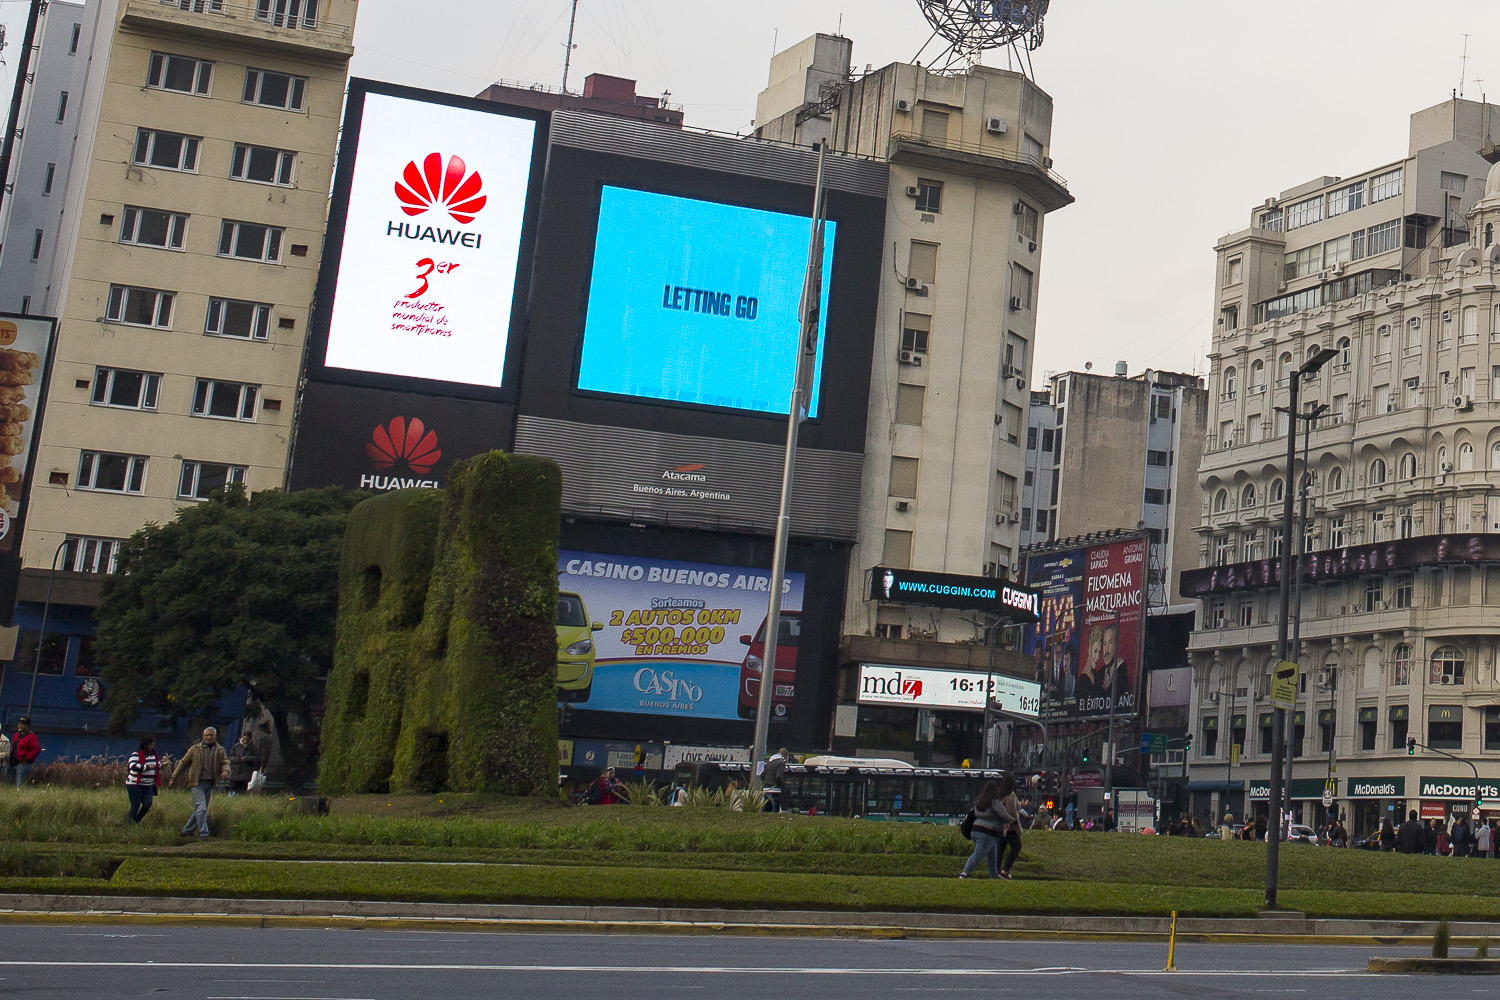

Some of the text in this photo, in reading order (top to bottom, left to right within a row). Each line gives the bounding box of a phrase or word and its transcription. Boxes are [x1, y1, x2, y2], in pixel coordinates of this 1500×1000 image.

[387, 220, 481, 249] HUAWEI
[393, 300, 445, 312] productor
[663, 284, 758, 321] LETTING GO
[393, 312, 448, 325] mundial de
[391, 323, 452, 337] smartphones
[360, 474, 438, 490] HUAWEI
[662, 471, 706, 481] Atacama
[633, 484, 730, 500] Buenos Aires, Argentina
[566, 559, 792, 594] CASINO BUENOS AIRS
[1087, 571, 1132, 592] FILOMENA
[899, 581, 996, 599] WWW.CUGGINI.COM
[651, 598, 704, 609] Sorteamos
[609, 610, 623, 626] 2
[625, 610, 694, 626] AUTOS
[621, 626, 725, 645] $500.000
[635, 644, 708, 655] EN PREMIOS
[633, 667, 703, 702] CASINO
[863, 672, 918, 696] mdz
[950, 678, 995, 693] 16:12
[639, 700, 694, 710] BUENOS AIRES
[1020, 695, 1039, 713] 16:12
[1079, 698, 1086, 711] EL
[1087, 695, 1105, 711] ÉXITO
[858, 767, 1004, 778] RECOLETA
[1354, 784, 1395, 795] McDonald's
[1452, 804, 1467, 812] CONO
